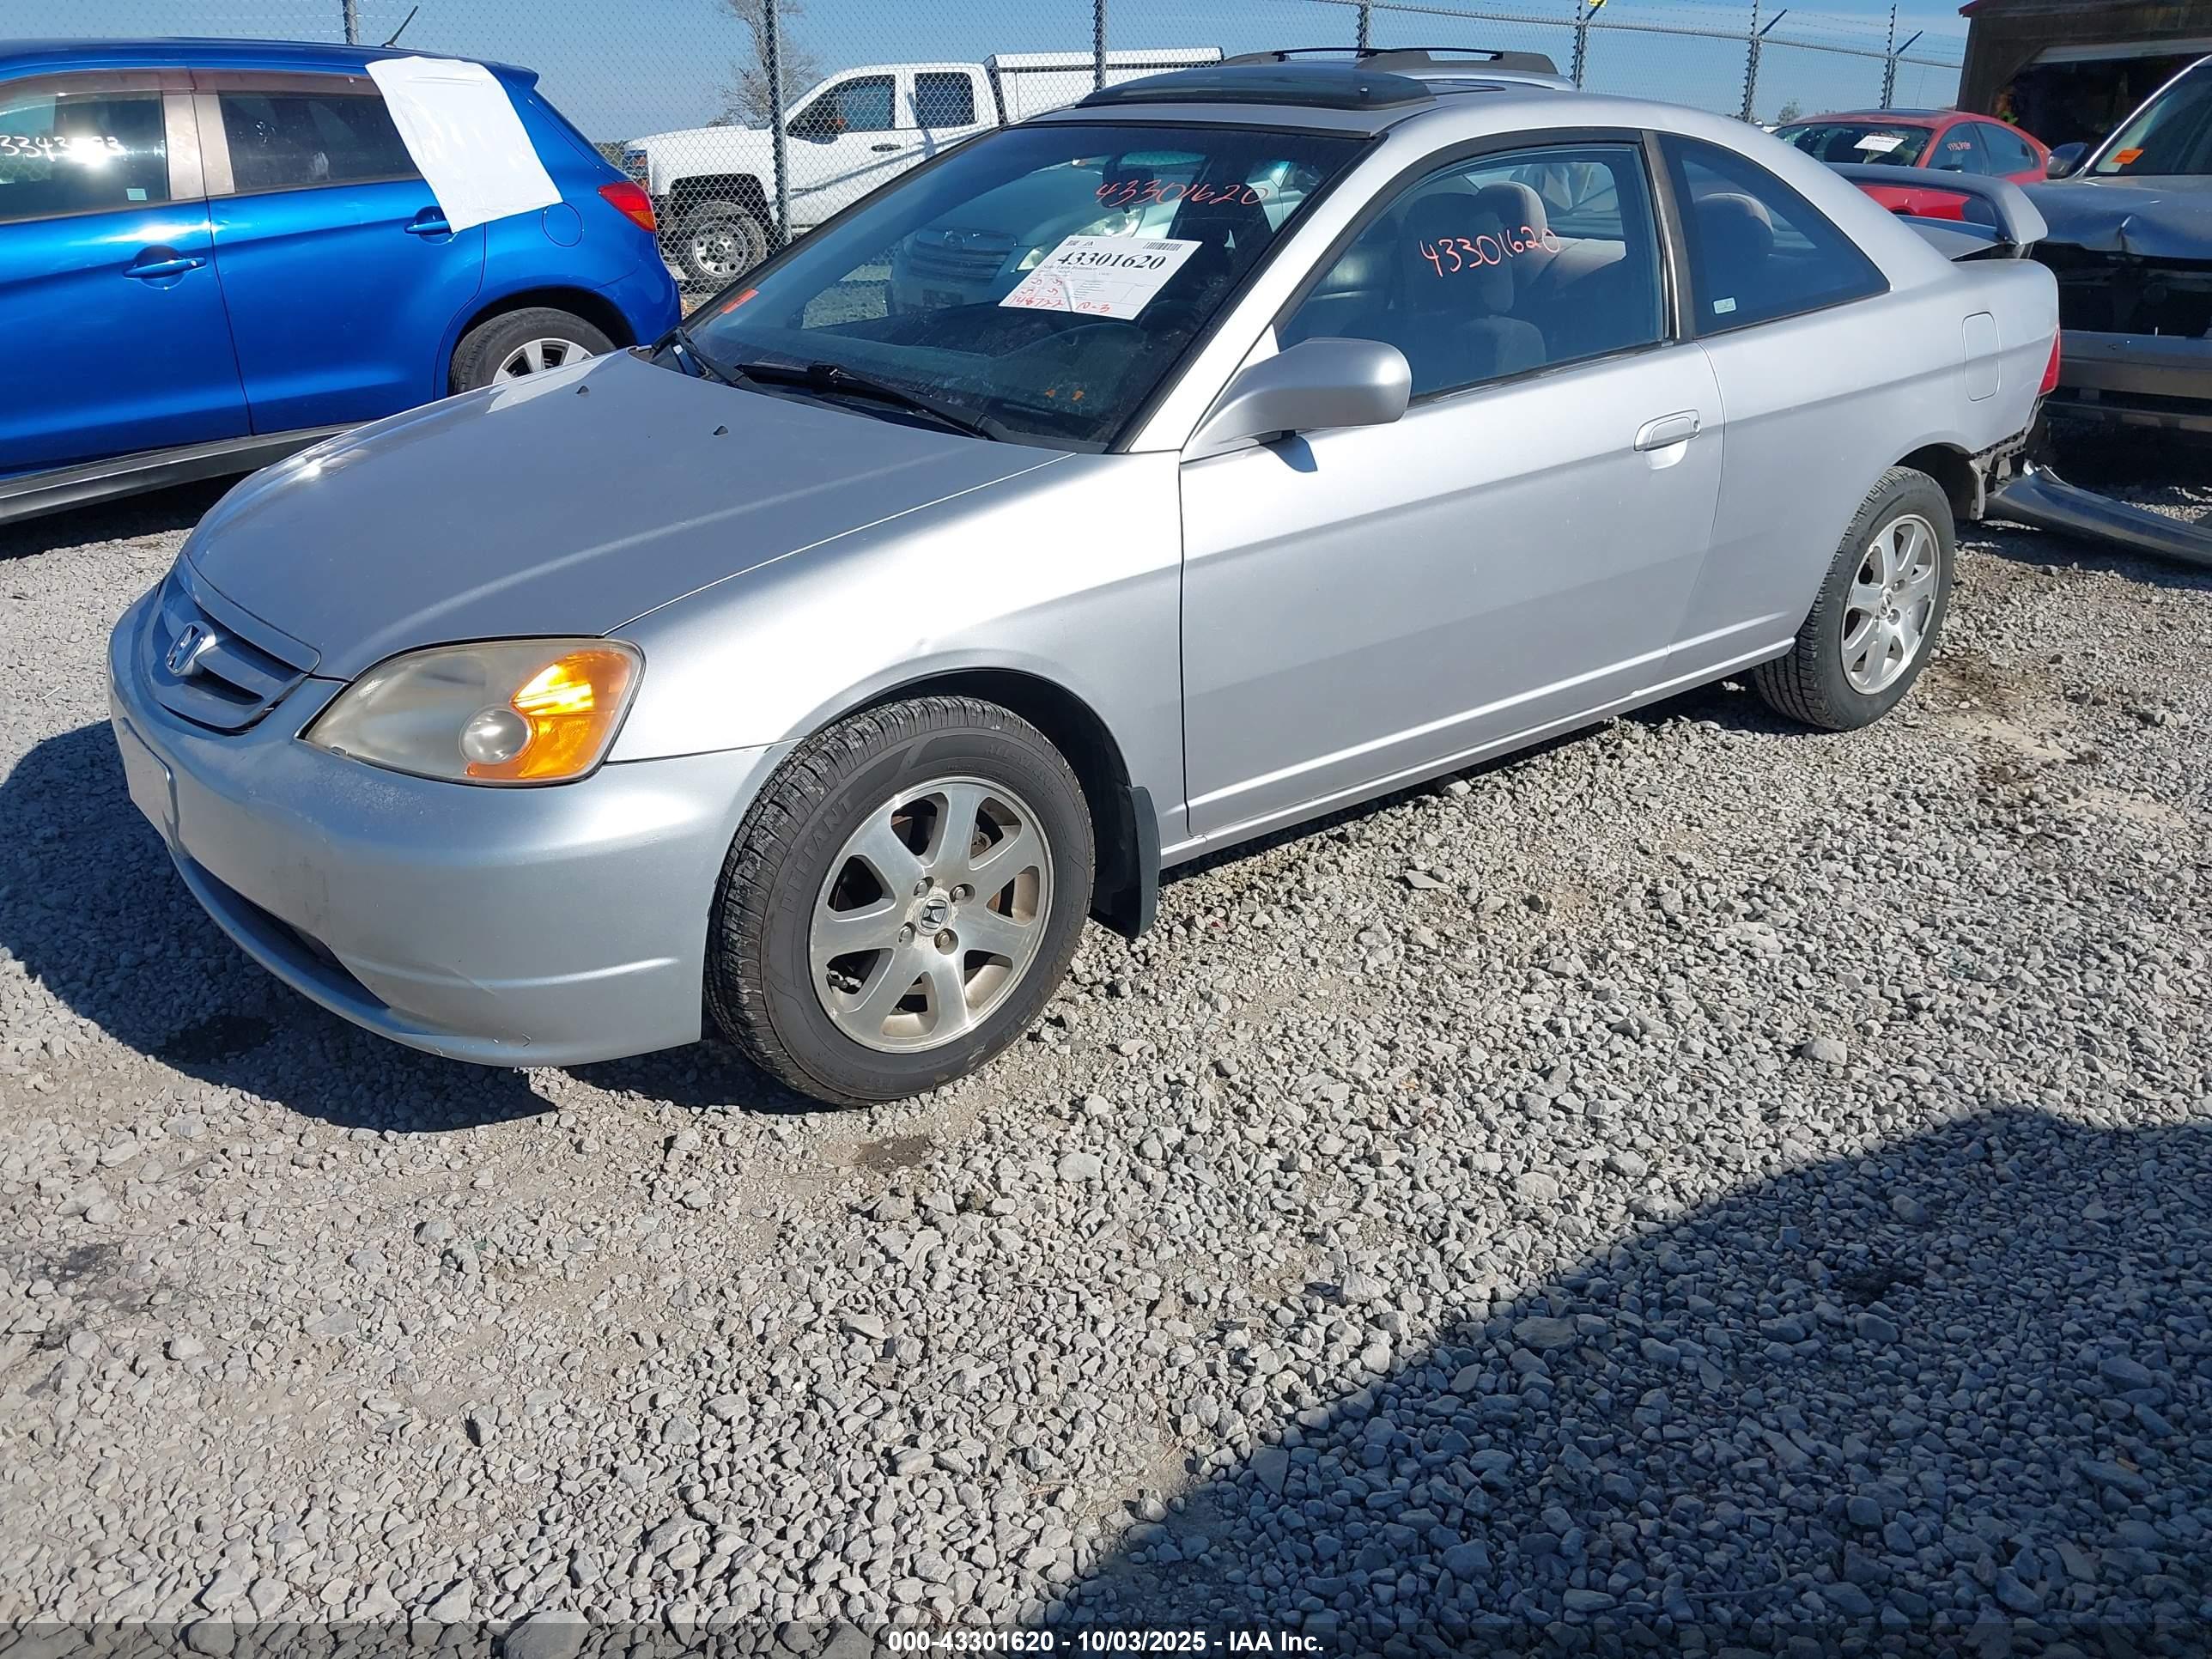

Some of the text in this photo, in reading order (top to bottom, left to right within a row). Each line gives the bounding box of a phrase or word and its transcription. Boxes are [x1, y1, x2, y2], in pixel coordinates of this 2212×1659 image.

[1095, 179, 1269, 207] 43301620
[1057, 250, 1168, 270] 43301620
[1419, 226, 1560, 277] 43301620
